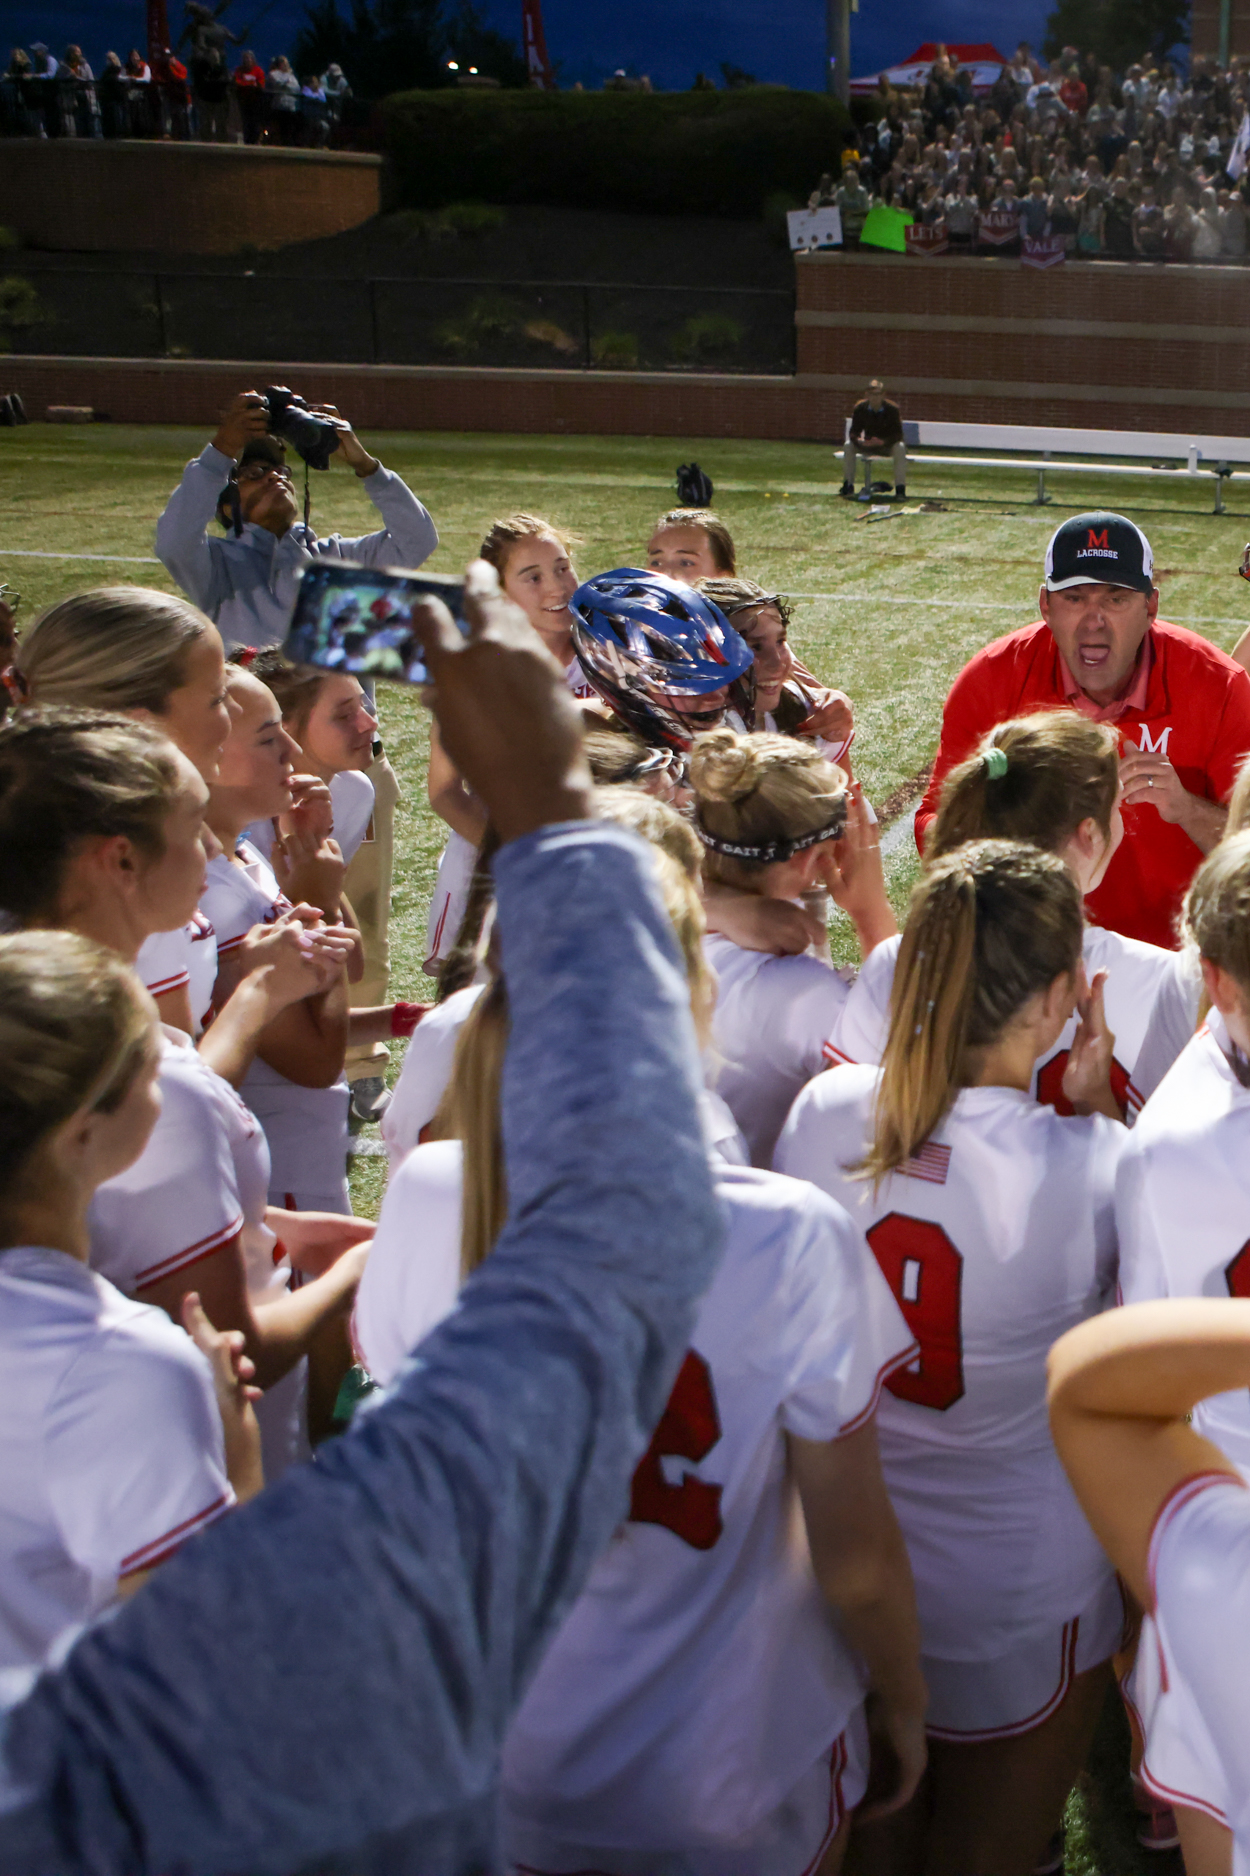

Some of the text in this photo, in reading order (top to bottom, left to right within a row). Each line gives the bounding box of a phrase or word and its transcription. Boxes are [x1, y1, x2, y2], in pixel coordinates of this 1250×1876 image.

[909, 226, 944, 241] LETS
[1087, 529, 1110, 548] M
[1076, 549, 1119, 560] LACROSSE
[1138, 723, 1173, 754] M
[722, 843, 761, 857] GAIT
[865, 1210, 966, 1412] 9
